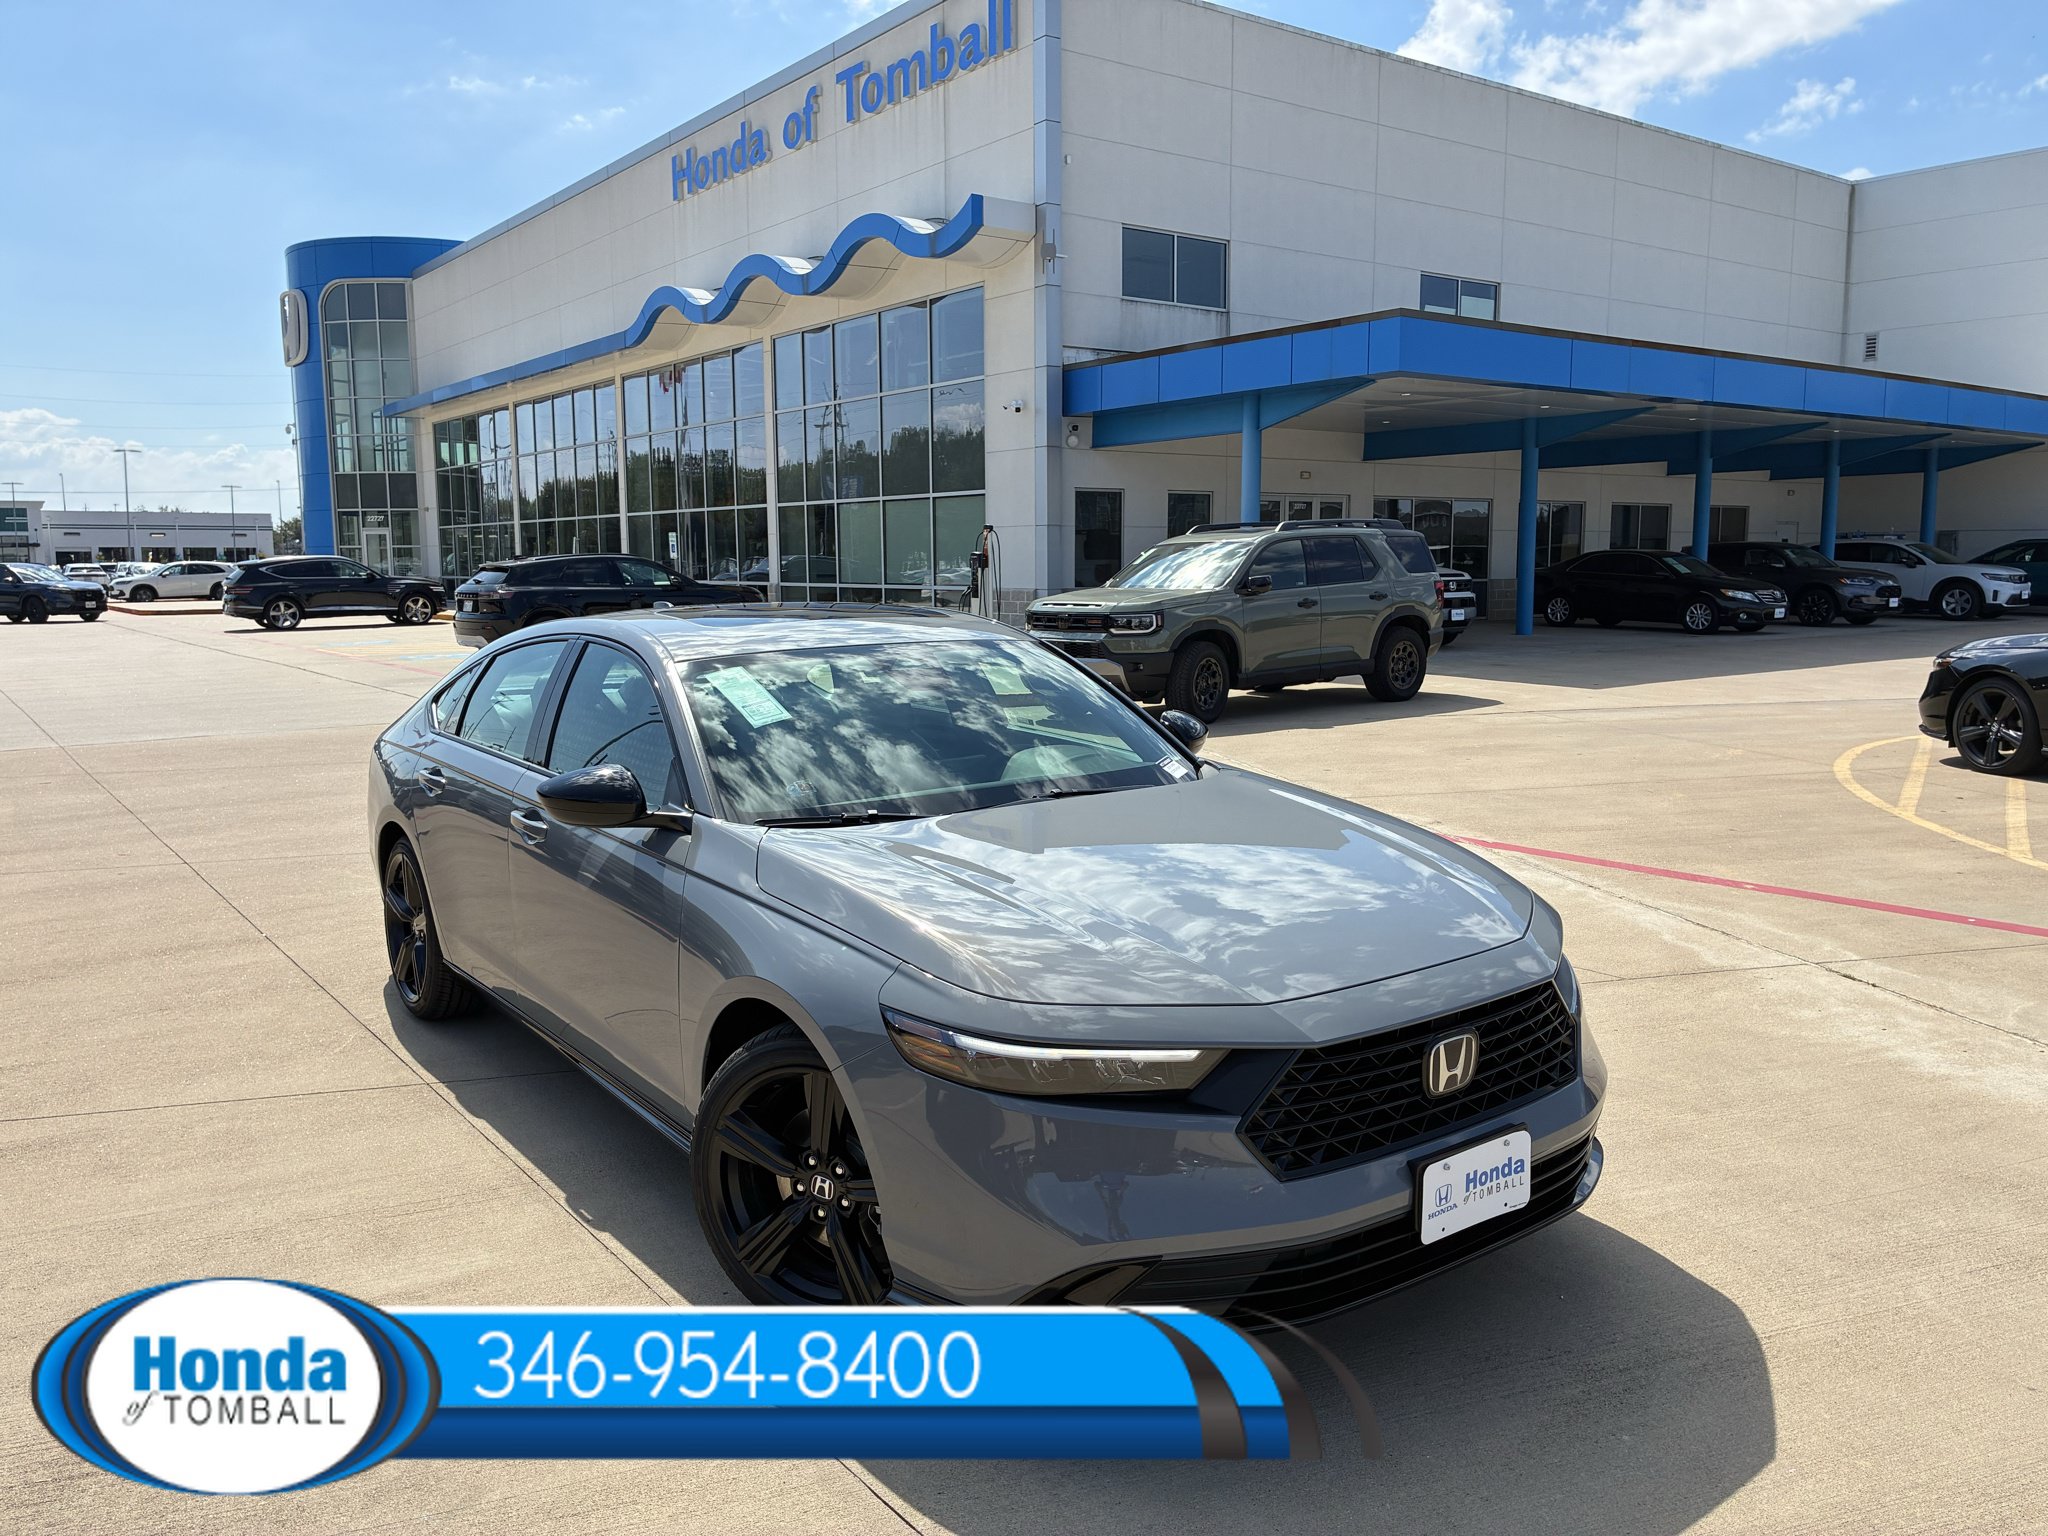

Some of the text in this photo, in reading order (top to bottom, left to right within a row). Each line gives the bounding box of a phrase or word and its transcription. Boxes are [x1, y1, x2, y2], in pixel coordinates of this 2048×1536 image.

[672, 0, 1015, 201] Honda of Tomball
[1463, 1176, 1524, 1206] of TOMBALL
[1465, 1157, 1525, 1193] Honda
[1427, 1203, 1458, 1220] HONDA
